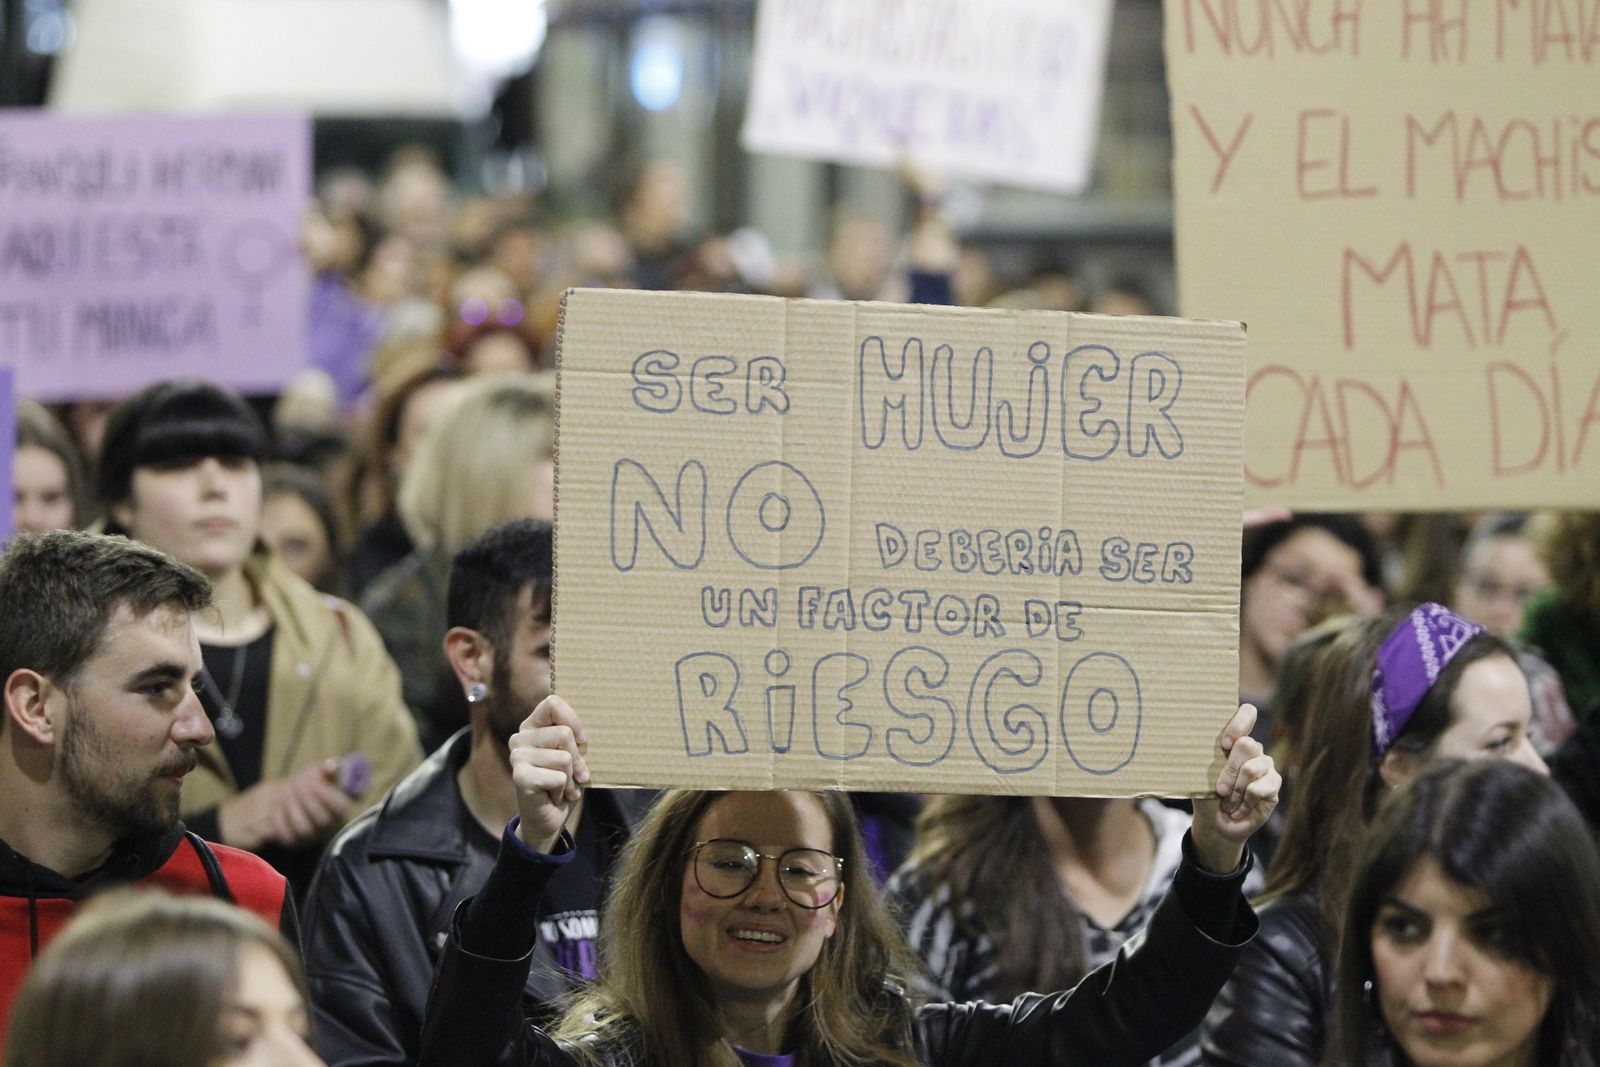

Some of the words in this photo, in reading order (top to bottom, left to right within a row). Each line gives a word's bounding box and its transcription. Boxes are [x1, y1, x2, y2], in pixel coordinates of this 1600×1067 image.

[1189, 104, 1254, 195] Y
[1297, 109, 1378, 199] EL
[1341, 241, 1559, 351] MATA
[630, 349, 790, 415] SER
[1243, 363, 1445, 491] CADA
[609, 459, 826, 572] NO
[1099, 536, 1195, 584] SER
[701, 587, 778, 628] UN
[799, 585, 1007, 638] FACTOR
[1023, 599, 1085, 642] DE
